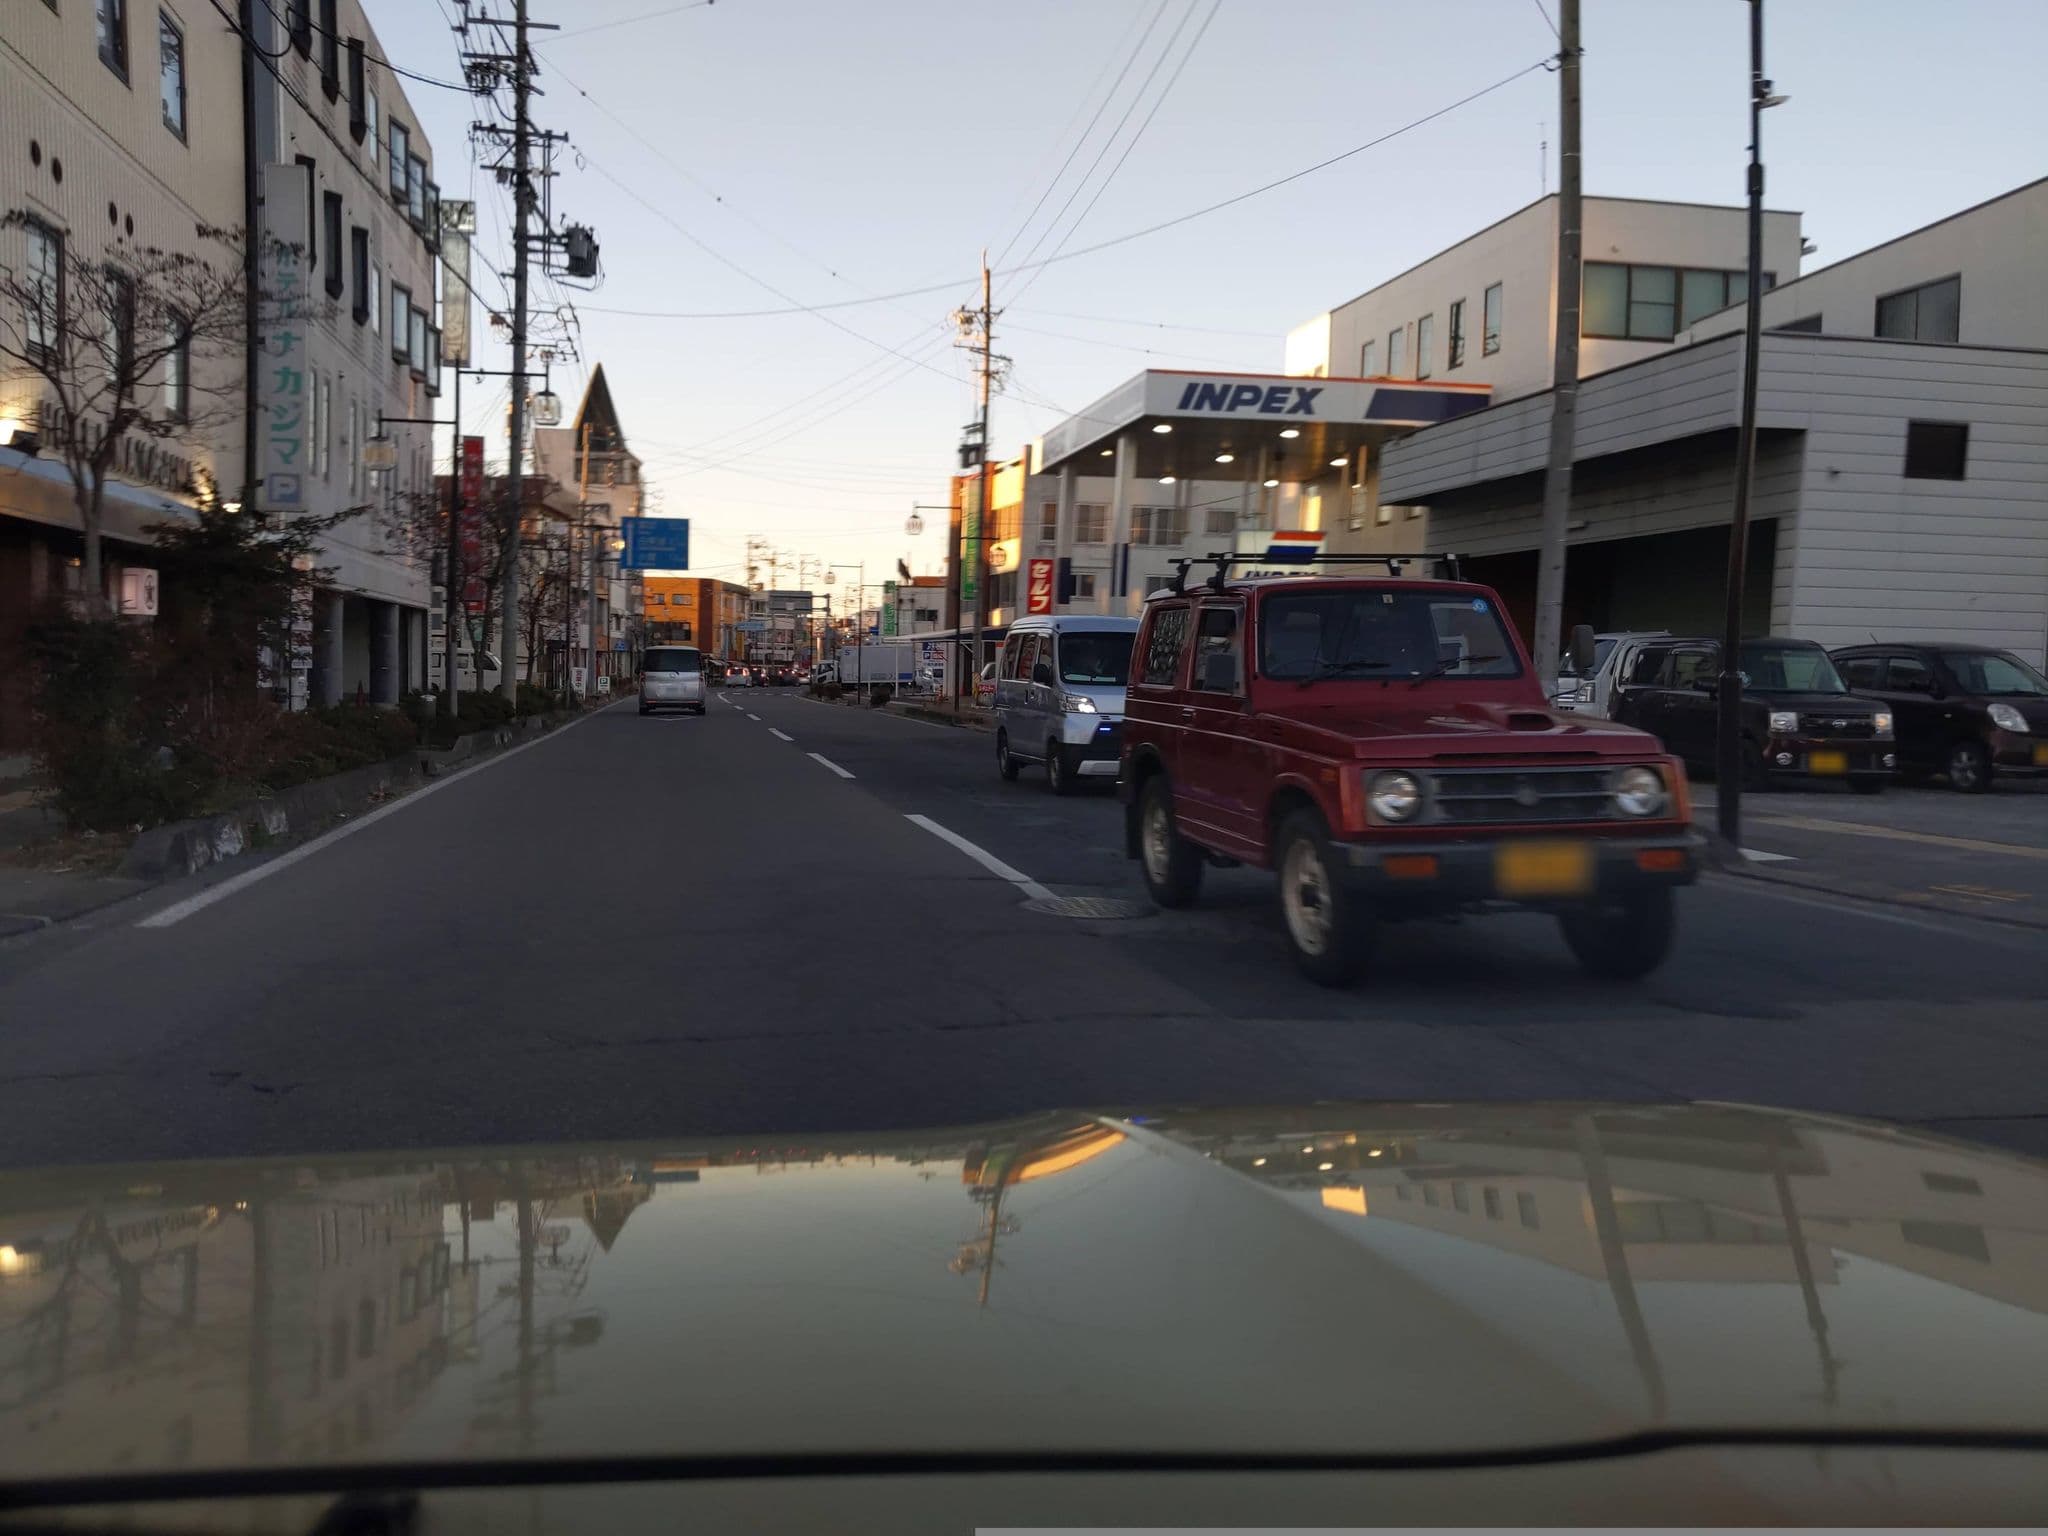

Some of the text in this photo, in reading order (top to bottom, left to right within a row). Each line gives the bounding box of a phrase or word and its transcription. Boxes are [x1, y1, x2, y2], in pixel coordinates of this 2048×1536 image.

[1177, 382, 1324, 415] INPEX
[1032, 562, 1050, 611] セルフ
